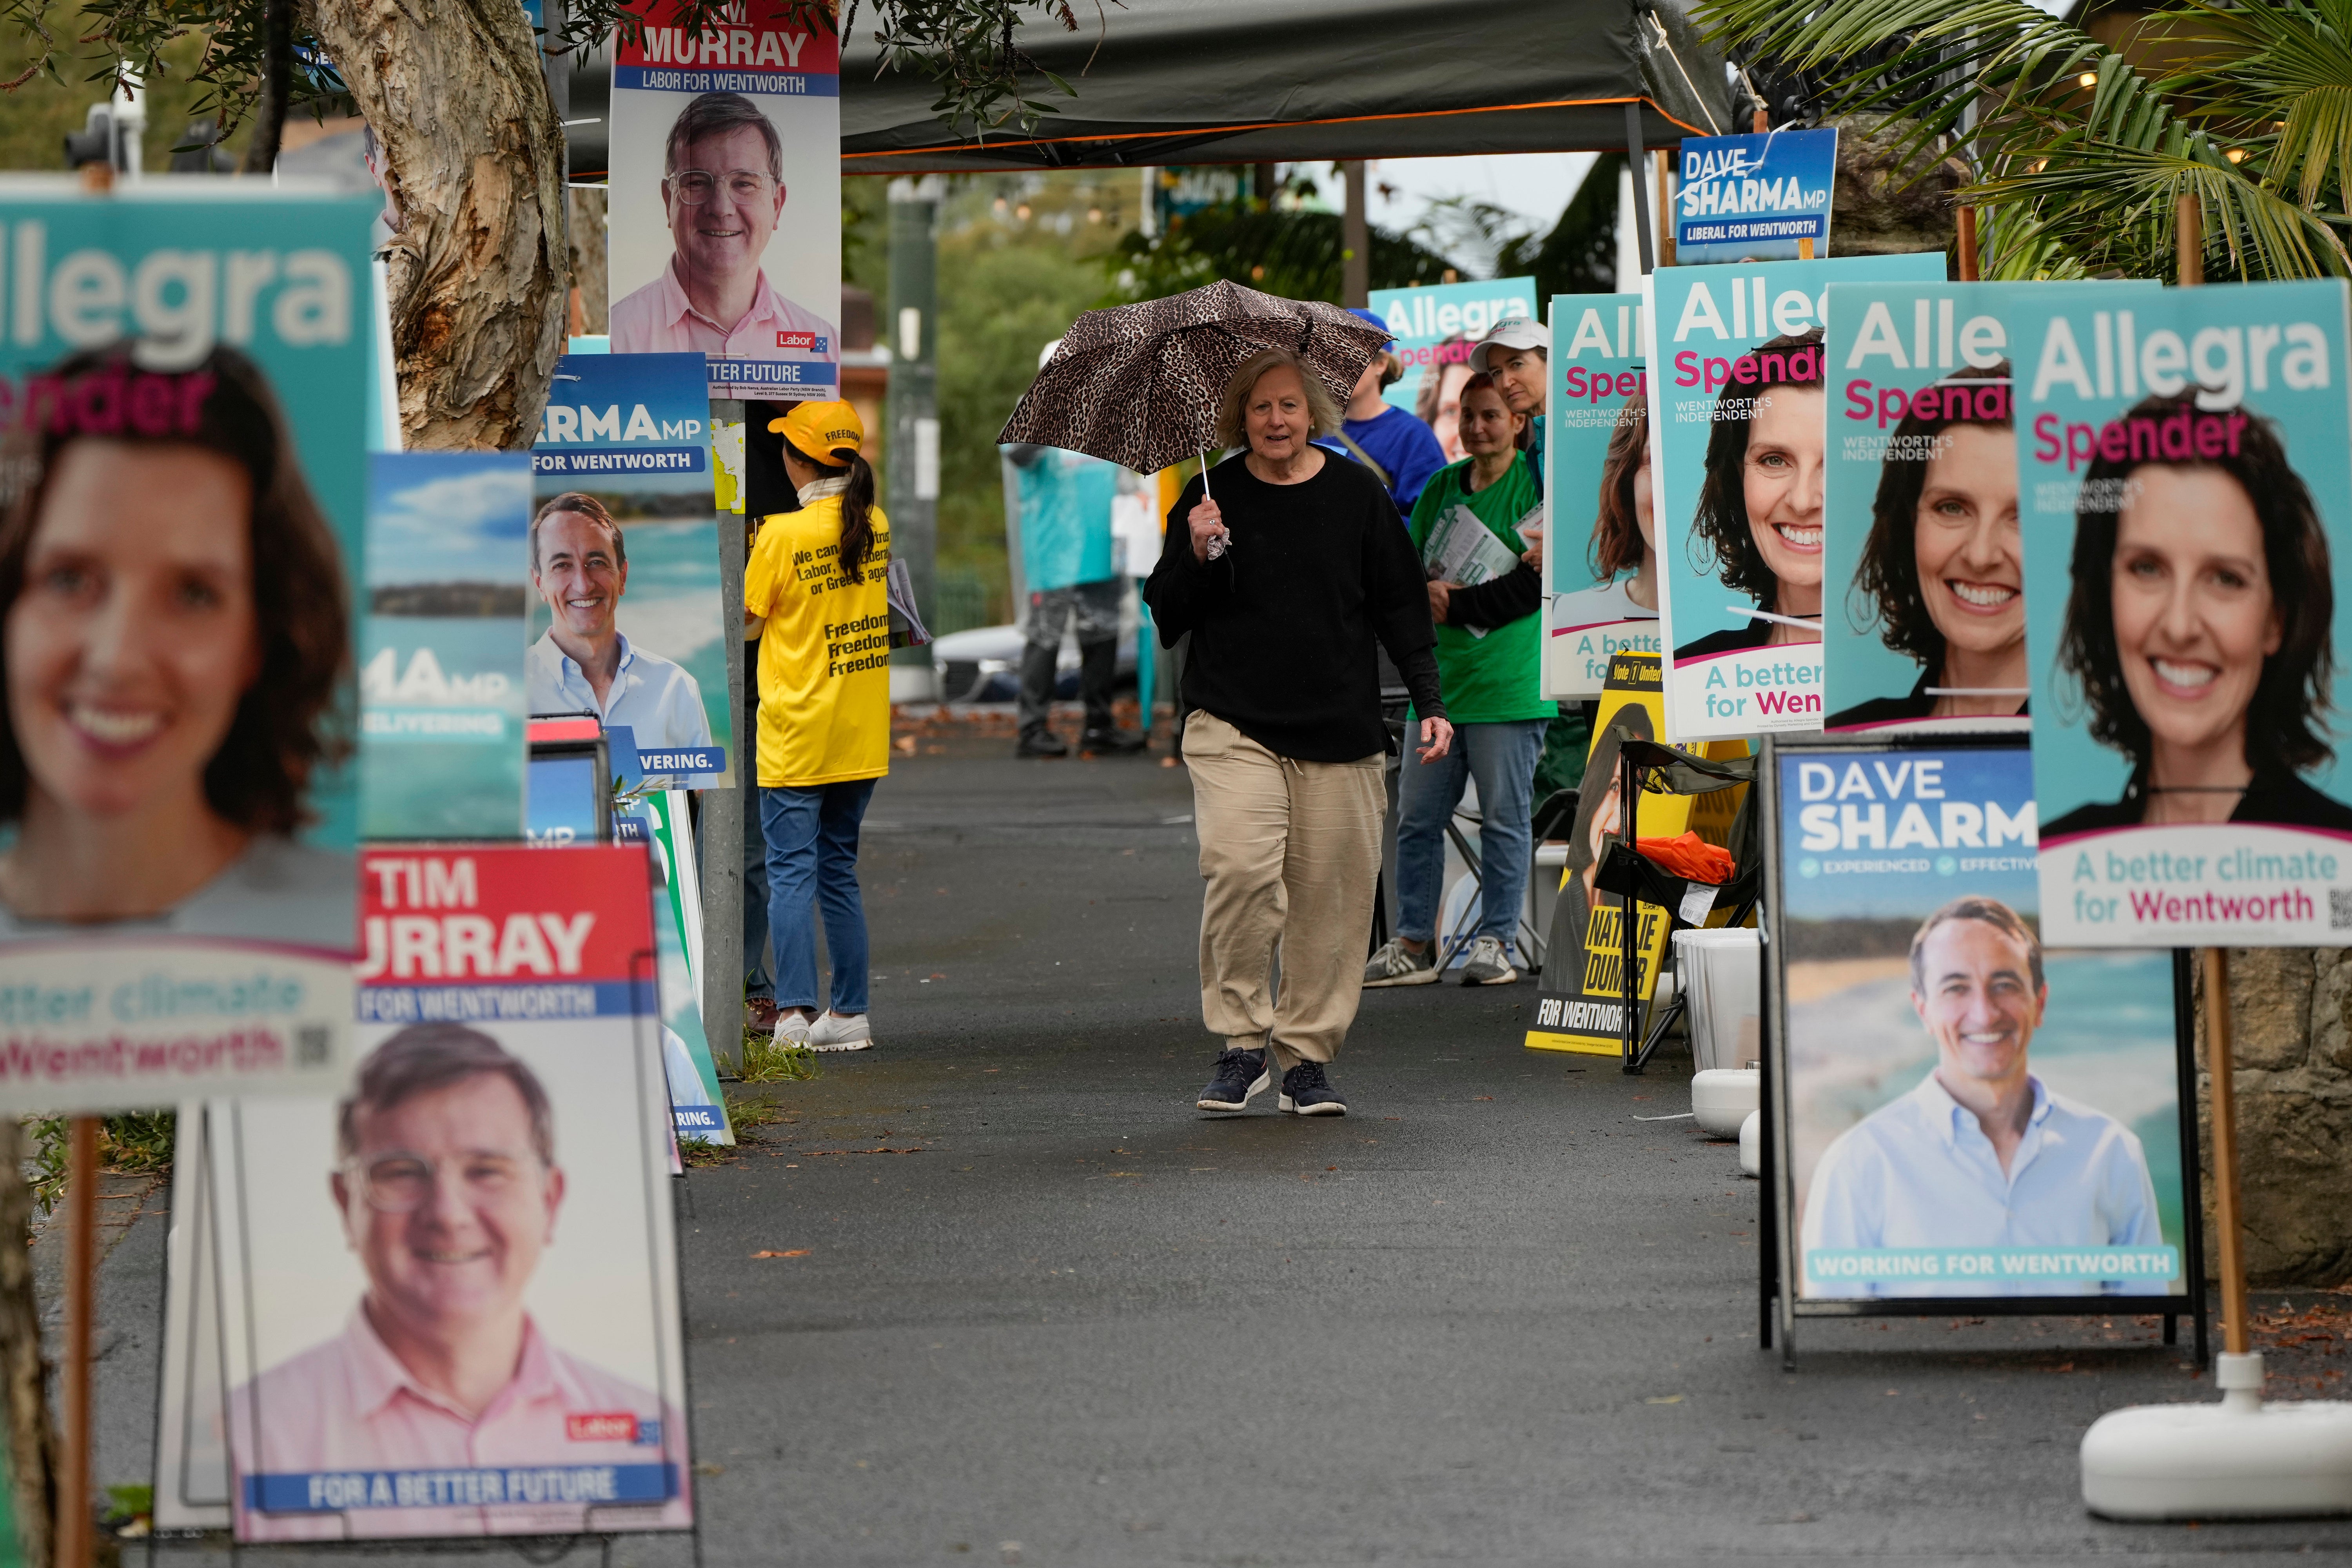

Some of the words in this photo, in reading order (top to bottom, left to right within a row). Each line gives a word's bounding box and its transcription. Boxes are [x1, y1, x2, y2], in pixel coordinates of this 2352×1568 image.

[643, 27, 807, 67] MURRAY
[642, 71, 680, 89] LABOR
[683, 73, 709, 91] FOR
[713, 74, 805, 93] WENTWORTH
[1686, 149, 1747, 180] DAVE
[1682, 176, 1803, 216] SHARMA
[1803, 190, 1826, 209] MP
[1687, 225, 1726, 240] LIBERAL
[1729, 223, 1748, 238] FOR
[1749, 220, 1817, 236] WENTWORTH
[1673, 276, 1827, 343] Alle
[780, 334, 811, 346] Labor
[1566, 305, 1646, 359] All
[1845, 299, 2007, 370] Alle
[1674, 342, 1825, 394] Spend
[2031, 309, 2331, 412] Allegra
[744, 364, 800, 382] FUTURE
[1566, 408, 1646, 418] WENTWORTH'S
[1675, 397, 1773, 412] WENTWORTH'S
[1845, 376, 2014, 429] Spend
[1565, 418, 1640, 428] INDEPENDENT
[1676, 408, 1765, 423] INDEPENDENT
[662, 419, 701, 441] MP
[825, 429, 860, 443] FREEDOM
[1843, 435, 1954, 448] WENTWORTH'S
[2033, 402, 2248, 474] Spender
[531, 456, 566, 470] FOR
[570, 452, 691, 470] WENTWORTH
[1842, 448, 1944, 461] INDEPENDENT
[792, 550, 813, 566] We
[816, 544, 838, 559] can
[797, 562, 837, 582] Labor,
[811, 583, 823, 595] or
[826, 571, 865, 591] Grees
[1576, 635, 1595, 655] A
[1586, 659, 1607, 679] fo
[1613, 664, 1630, 681] Vote
[1639, 665, 1662, 682] United
[1706, 666, 1727, 689] A
[1736, 662, 1822, 688] better
[1706, 693, 1747, 718] for
[1755, 690, 1822, 715] Wen
[1798, 760, 1945, 801] DAVE
[1799, 800, 2038, 852] SHARM
[1823, 858, 1931, 873] EXPERIENCED
[2073, 851, 2096, 883] A
[2107, 849, 2206, 883] better
[2217, 846, 2338, 882] climate
[366, 857, 479, 909] TIM
[2073, 889, 2120, 924] for
[2130, 886, 2314, 923] Wentworth
[359, 987, 417, 1020] FOR
[418, 984, 597, 1018] WENTWORTH
[1537, 999, 1561, 1026] FOR
[1815, 1256, 1940, 1276] WORKING
[1947, 1255, 1995, 1275] FOR
[2000, 1252, 2171, 1274] WENTWORTH
[308, 1475, 367, 1509] FOR
[370, 1474, 393, 1506] A
[396, 1470, 505, 1505] BETTER
[507, 1468, 616, 1502] FUTURE
